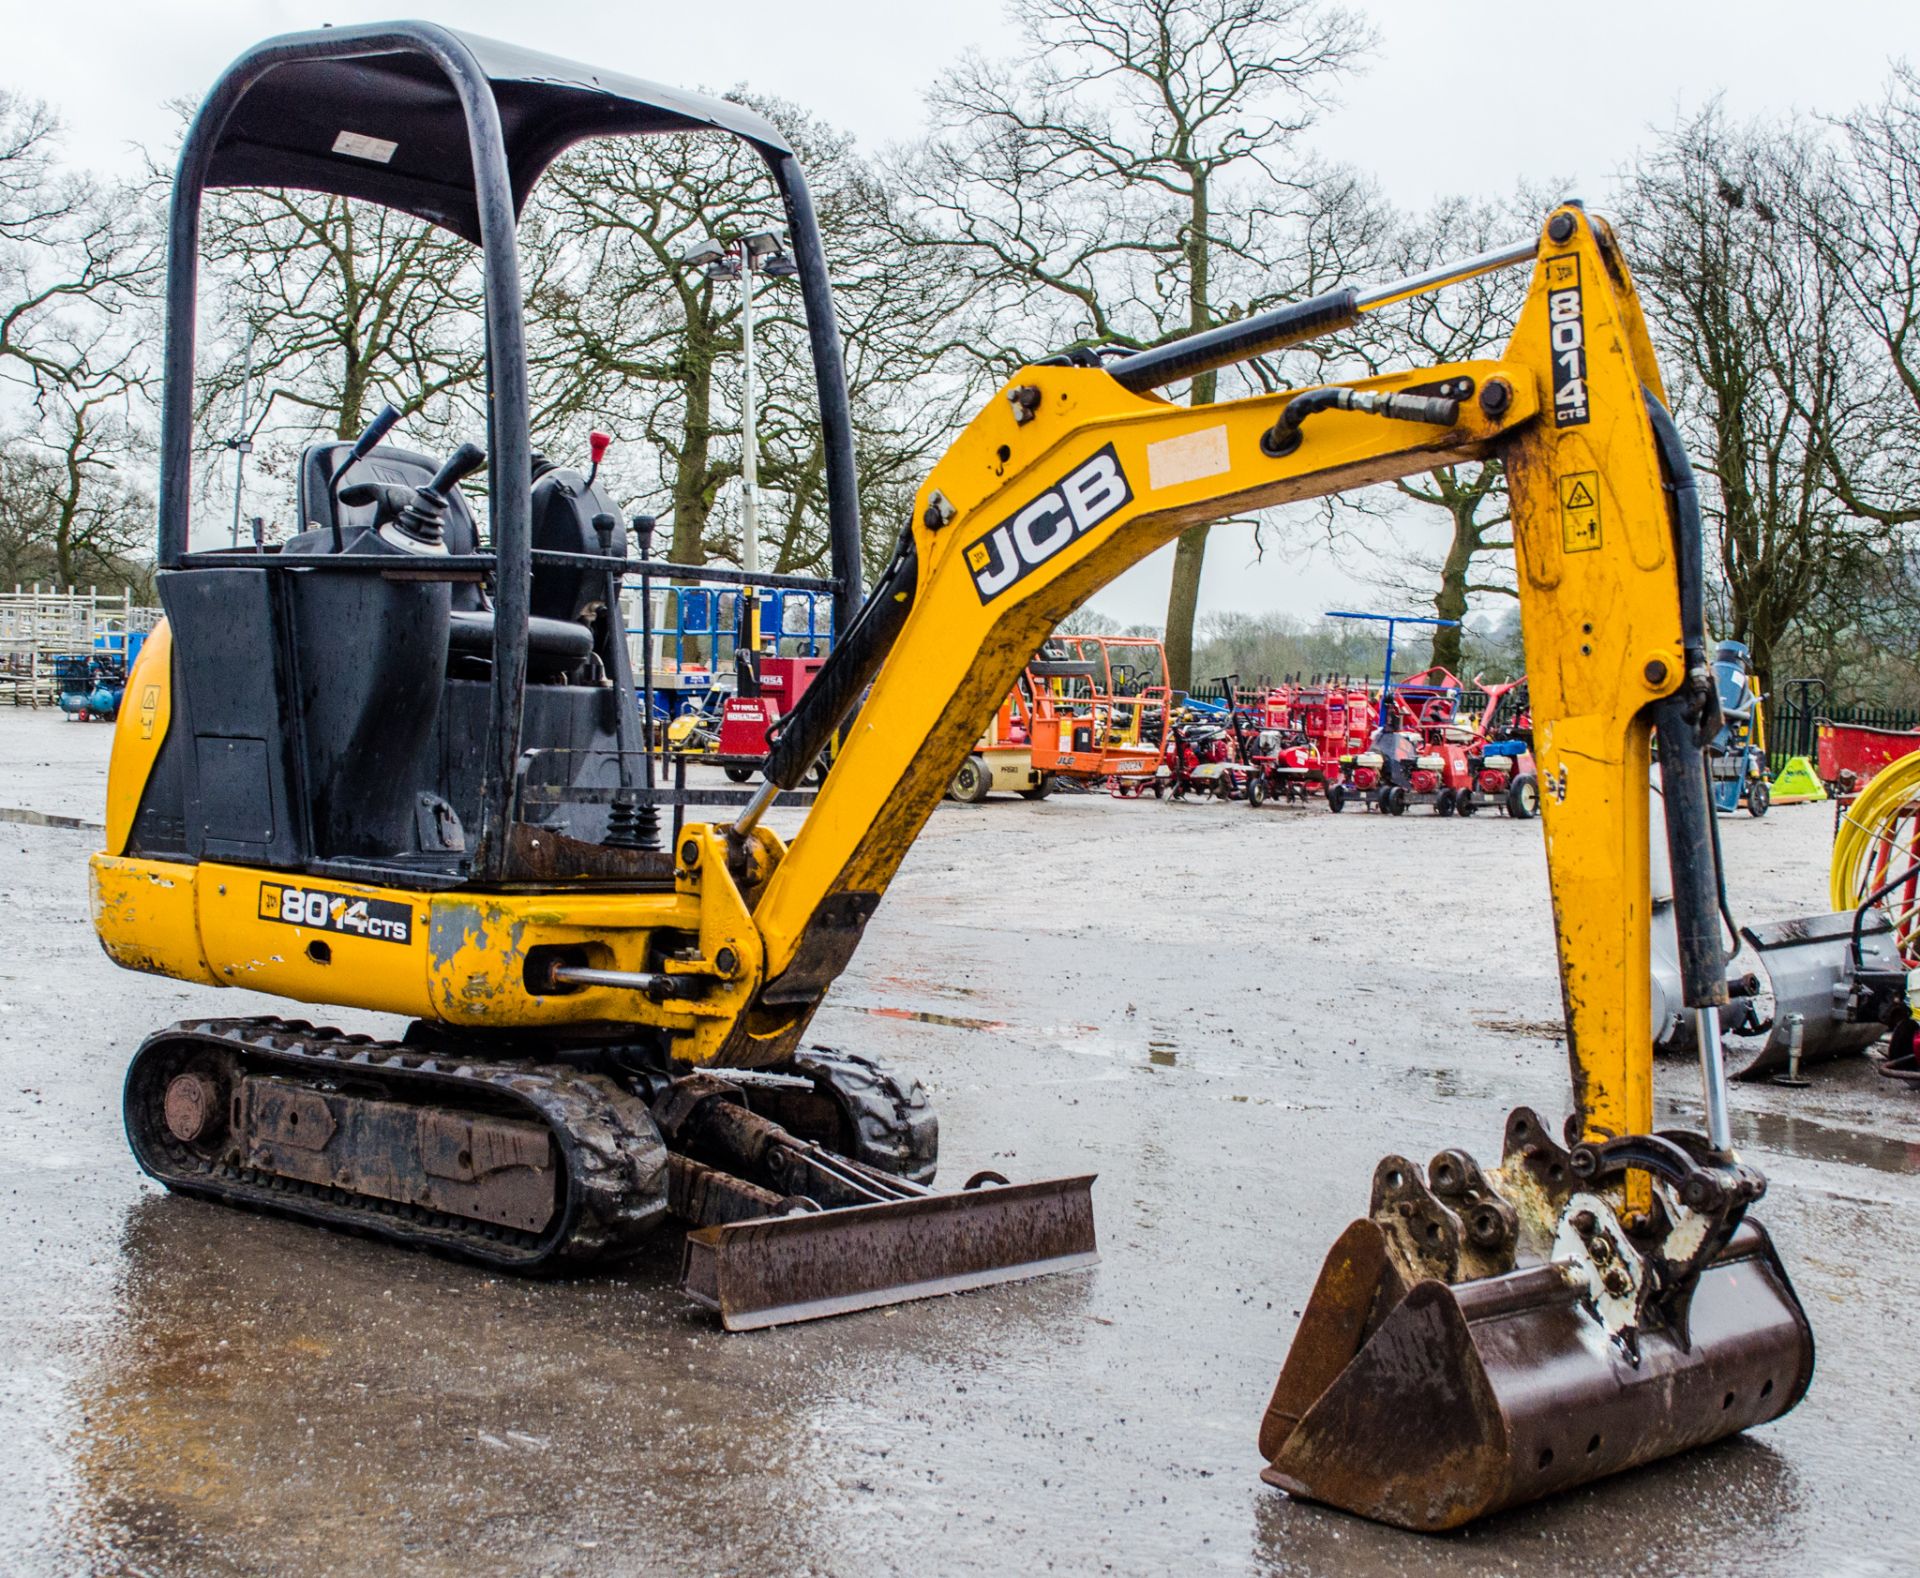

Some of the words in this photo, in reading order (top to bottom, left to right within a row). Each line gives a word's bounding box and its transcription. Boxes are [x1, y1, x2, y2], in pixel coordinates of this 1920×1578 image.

[1549, 290, 1586, 408] 8014
[1557, 407, 1587, 421] CTS
[976, 454, 1127, 596] JCB
[281, 888, 369, 934] 8014
[367, 917, 407, 941] CTS
